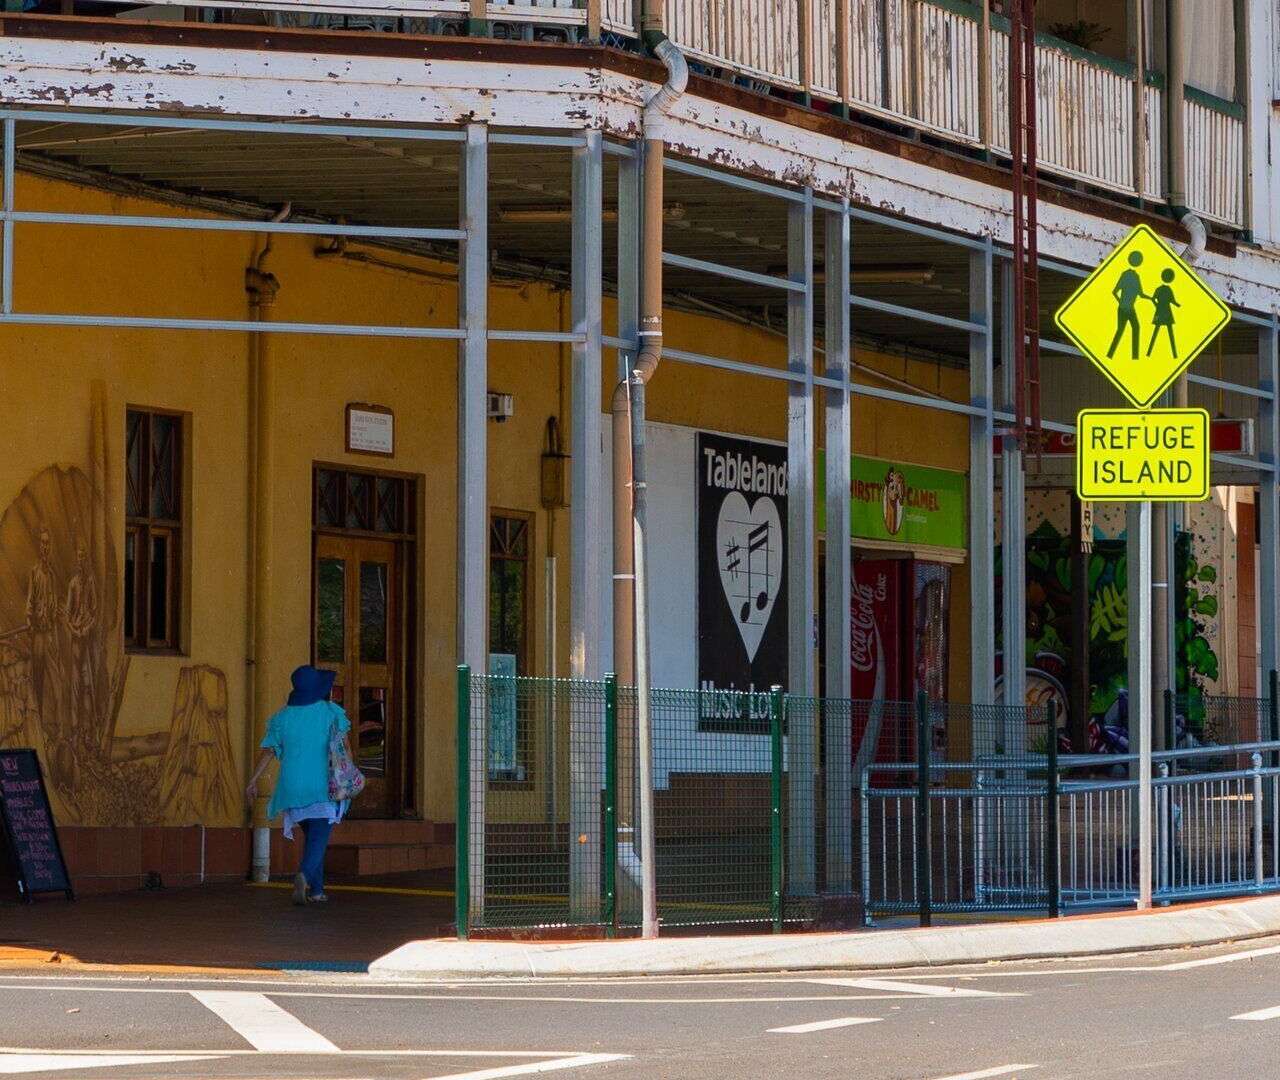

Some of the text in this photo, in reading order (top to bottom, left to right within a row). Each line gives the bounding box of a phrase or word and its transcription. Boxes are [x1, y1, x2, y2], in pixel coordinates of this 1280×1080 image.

[1091, 426, 1195, 450] REFUGE
[703, 447, 789, 497] Tableland
[1093, 460, 1193, 484] ISLAND
[906, 486, 940, 512] CAMEL
[873, 572, 887, 602] Coke
